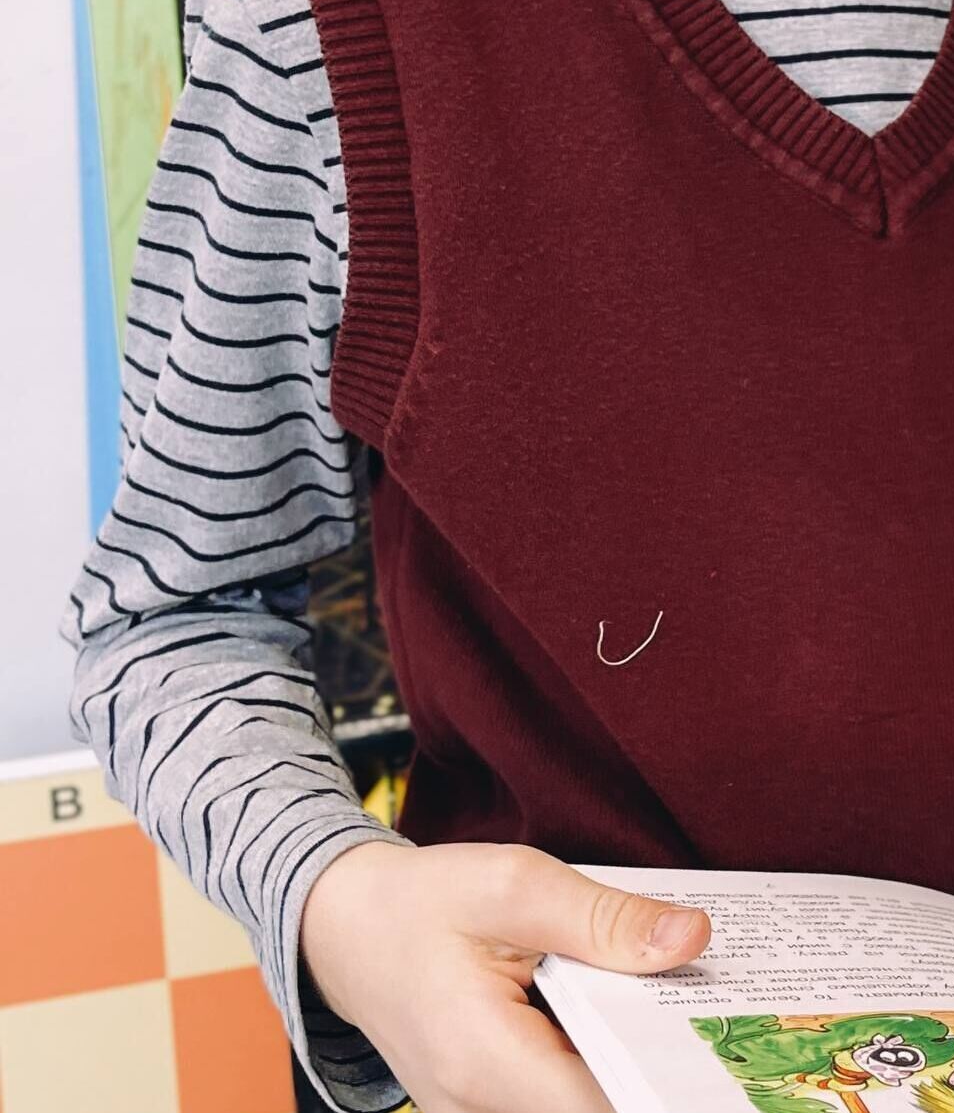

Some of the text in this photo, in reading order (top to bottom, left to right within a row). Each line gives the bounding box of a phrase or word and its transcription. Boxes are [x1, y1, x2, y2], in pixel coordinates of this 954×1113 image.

[50, 785, 84, 823] B
[678, 978, 753, 986] очистят,
[727, 985, 813, 993] спрятать,
[657, 997, 731, 1006] орешки
